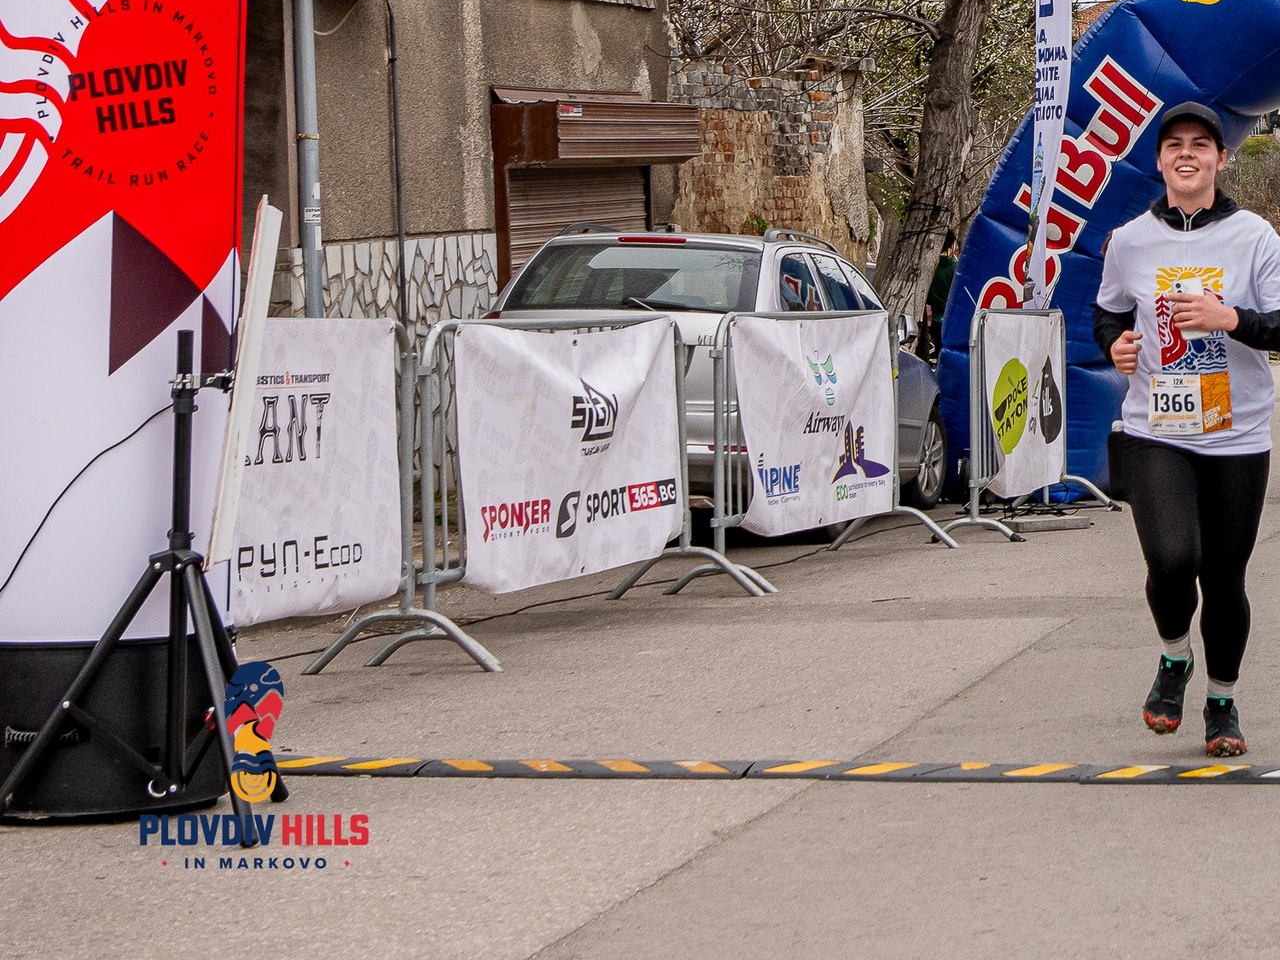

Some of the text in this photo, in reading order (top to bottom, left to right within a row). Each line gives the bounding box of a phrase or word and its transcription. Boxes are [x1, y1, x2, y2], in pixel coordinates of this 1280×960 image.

[35, 31, 67, 120] PLOVDIV
[143, 0, 164, 14] IN
[172, 10, 217, 96] MARKOVO
[67, 58, 188, 102] PLOVDIV
[95, 96, 176, 134] HILLS
[1054, 61, 1157, 204] Bull
[61, 131, 209, 187] TRAIL RUN RACE
[256, 375, 284, 385] STICS
[291, 373, 331, 383] TRANSPORT
[997, 396, 1028, 440] STATON
[1152, 393, 1195, 413] 1366
[245, 393, 331, 466] ANT
[481, 499, 551, 543] SPONSER
[586, 486, 627, 524] SPORT
[836, 484, 849, 501] ECO
